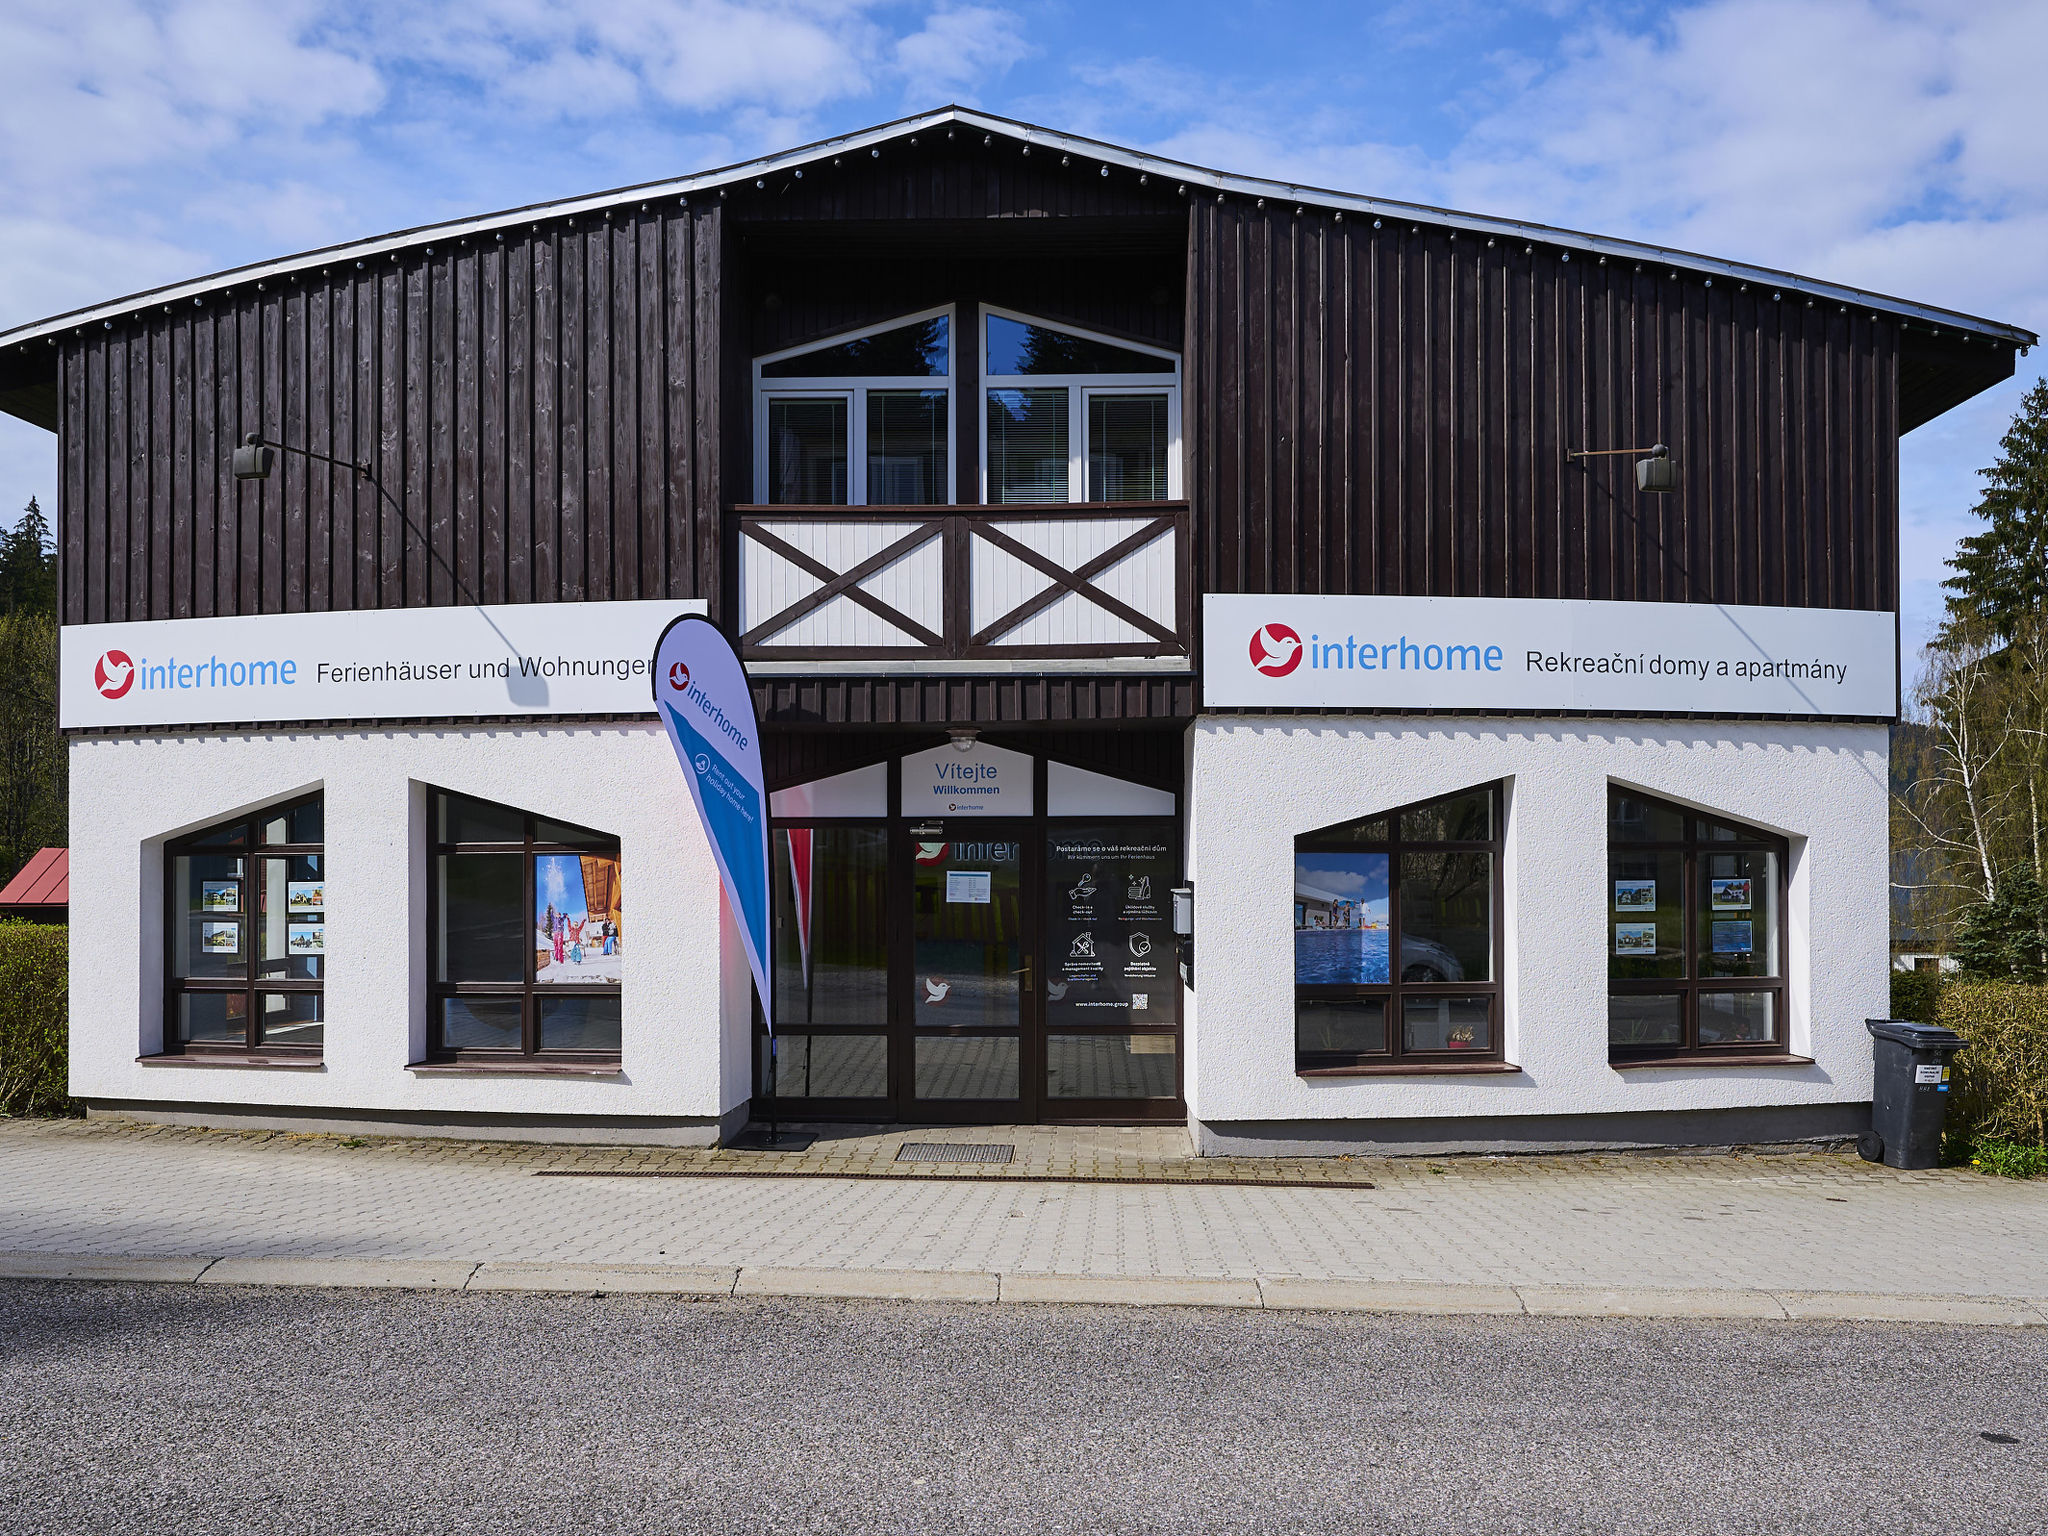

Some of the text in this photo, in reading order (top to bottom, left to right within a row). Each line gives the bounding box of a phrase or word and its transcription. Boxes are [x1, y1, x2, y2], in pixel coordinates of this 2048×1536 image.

[141, 654, 297, 691] interhome
[316, 660, 462, 684] Ferienhäuser
[468, 657, 510, 679] und
[1311, 633, 1847, 685] interhome Rekreační domy a apartmány
[687, 680, 749, 751] interhome
[711, 763, 746, 800] Rent out your
[933, 785, 1000, 795] Willkommen
[935, 763, 998, 783] Vítejte
[705, 773, 727, 798] holiday
[726, 792, 742, 811] home
[956, 803, 984, 811] interhome
